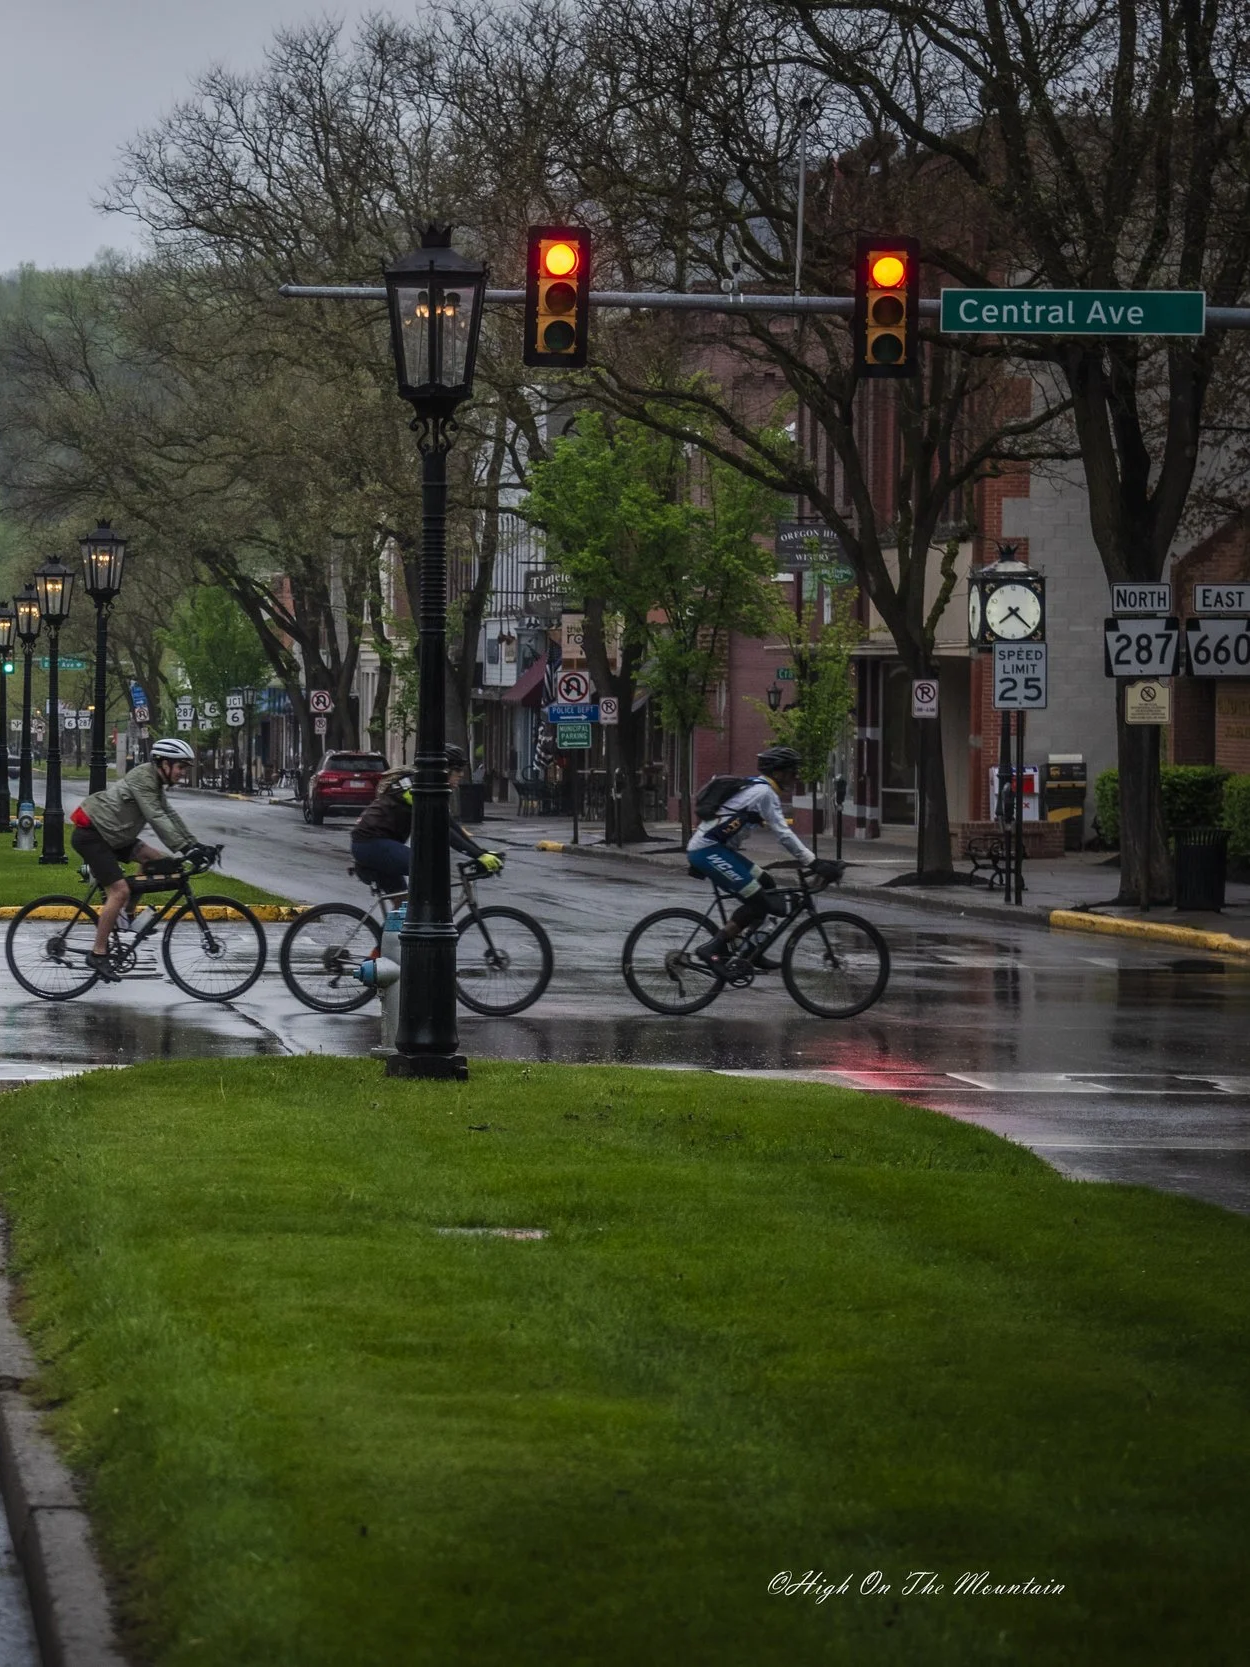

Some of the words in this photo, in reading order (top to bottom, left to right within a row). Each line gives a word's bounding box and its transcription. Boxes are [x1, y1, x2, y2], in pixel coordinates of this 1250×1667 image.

[959, 298, 1075, 324] Central
[1086, 300, 1144, 325] Ave
[780, 529, 819, 542] OREGON
[823, 529, 839, 541] HIL
[530, 573, 571, 589] Timele
[1116, 589, 1167, 608] NORTH
[1202, 589, 1244, 607] EAST
[1114, 633, 1172, 665] 287
[1194, 633, 1250, 665] 660
[998, 650, 1042, 661] SPEED
[1002, 664, 1038, 674] LIMIT
[998, 677, 1042, 701] 25
[227, 697, 241, 706] JCT
[177, 708, 193, 717] 287
[209, 703, 216, 713] 6
[552, 706, 574, 714] POLICE
[577, 706, 594, 714] DEPT
[231, 712, 239, 722] 6
[559, 725, 589, 733] MUNICIPAL
[561, 732, 588, 740] PARKING
